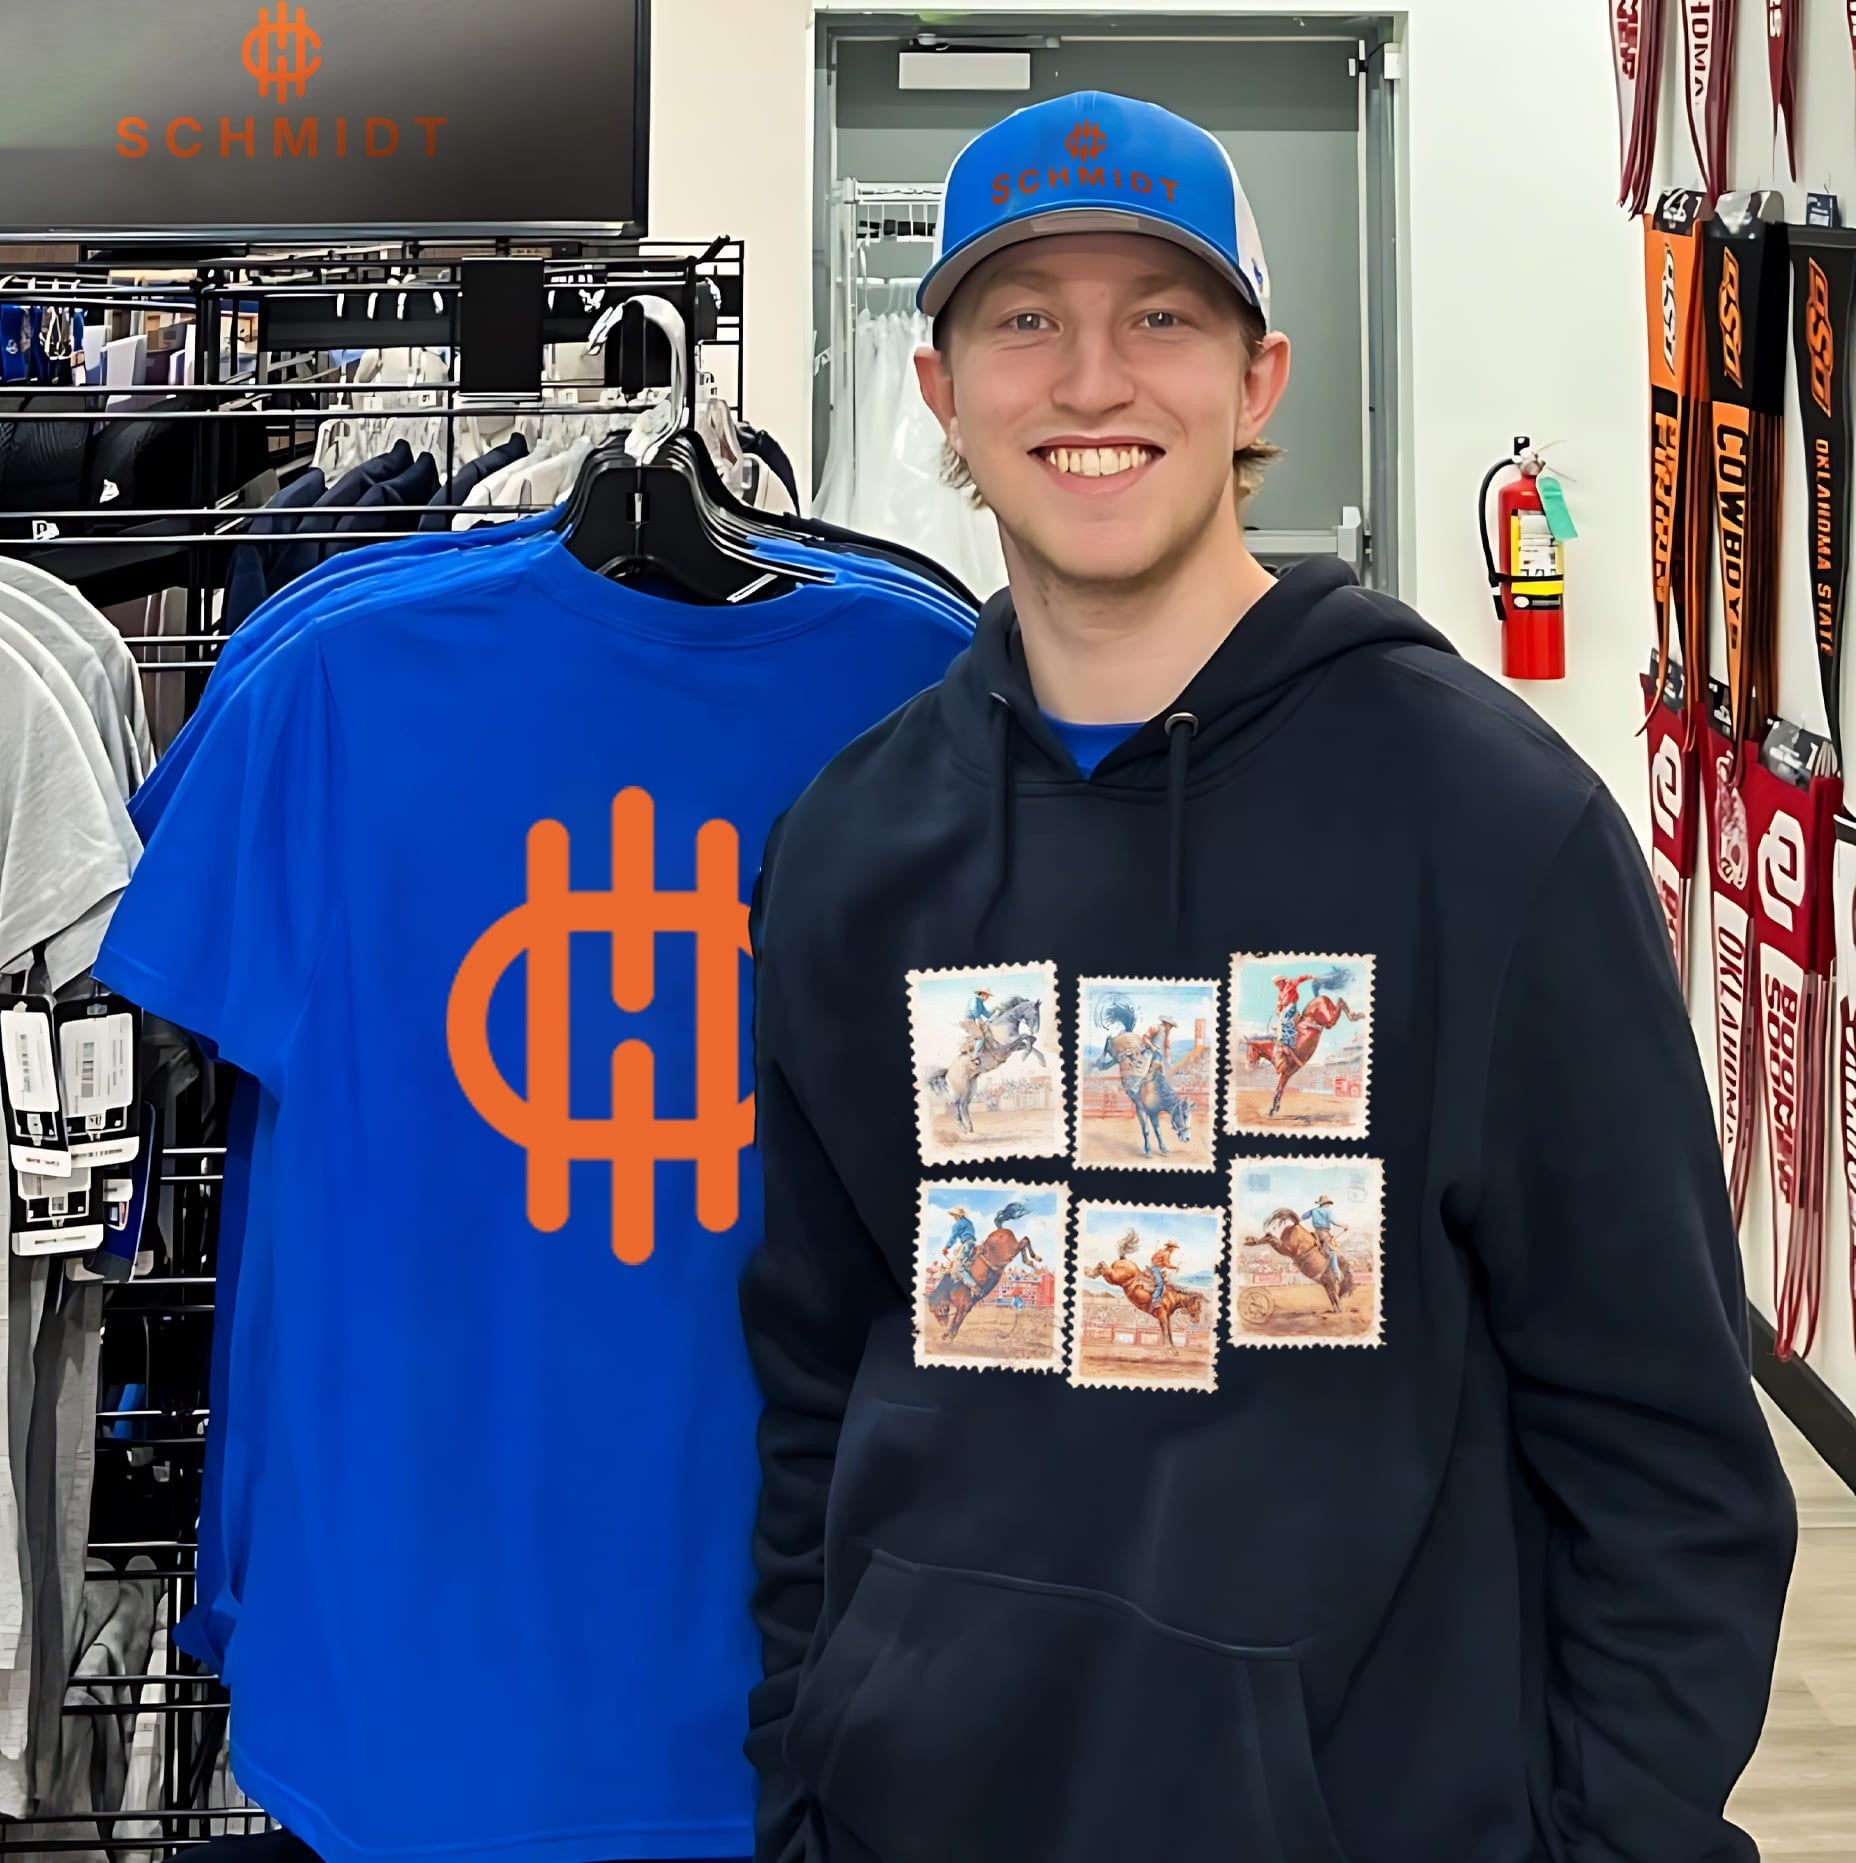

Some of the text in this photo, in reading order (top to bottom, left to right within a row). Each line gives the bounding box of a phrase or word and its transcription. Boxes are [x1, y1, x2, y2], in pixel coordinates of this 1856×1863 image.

[116, 117, 447, 158] SCHMIDT
[991, 167, 1179, 204] SCHMIDT
[1815, 439, 1832, 570] OKLAHOMA
[1719, 926, 1745, 1143] OKLAHOMA
